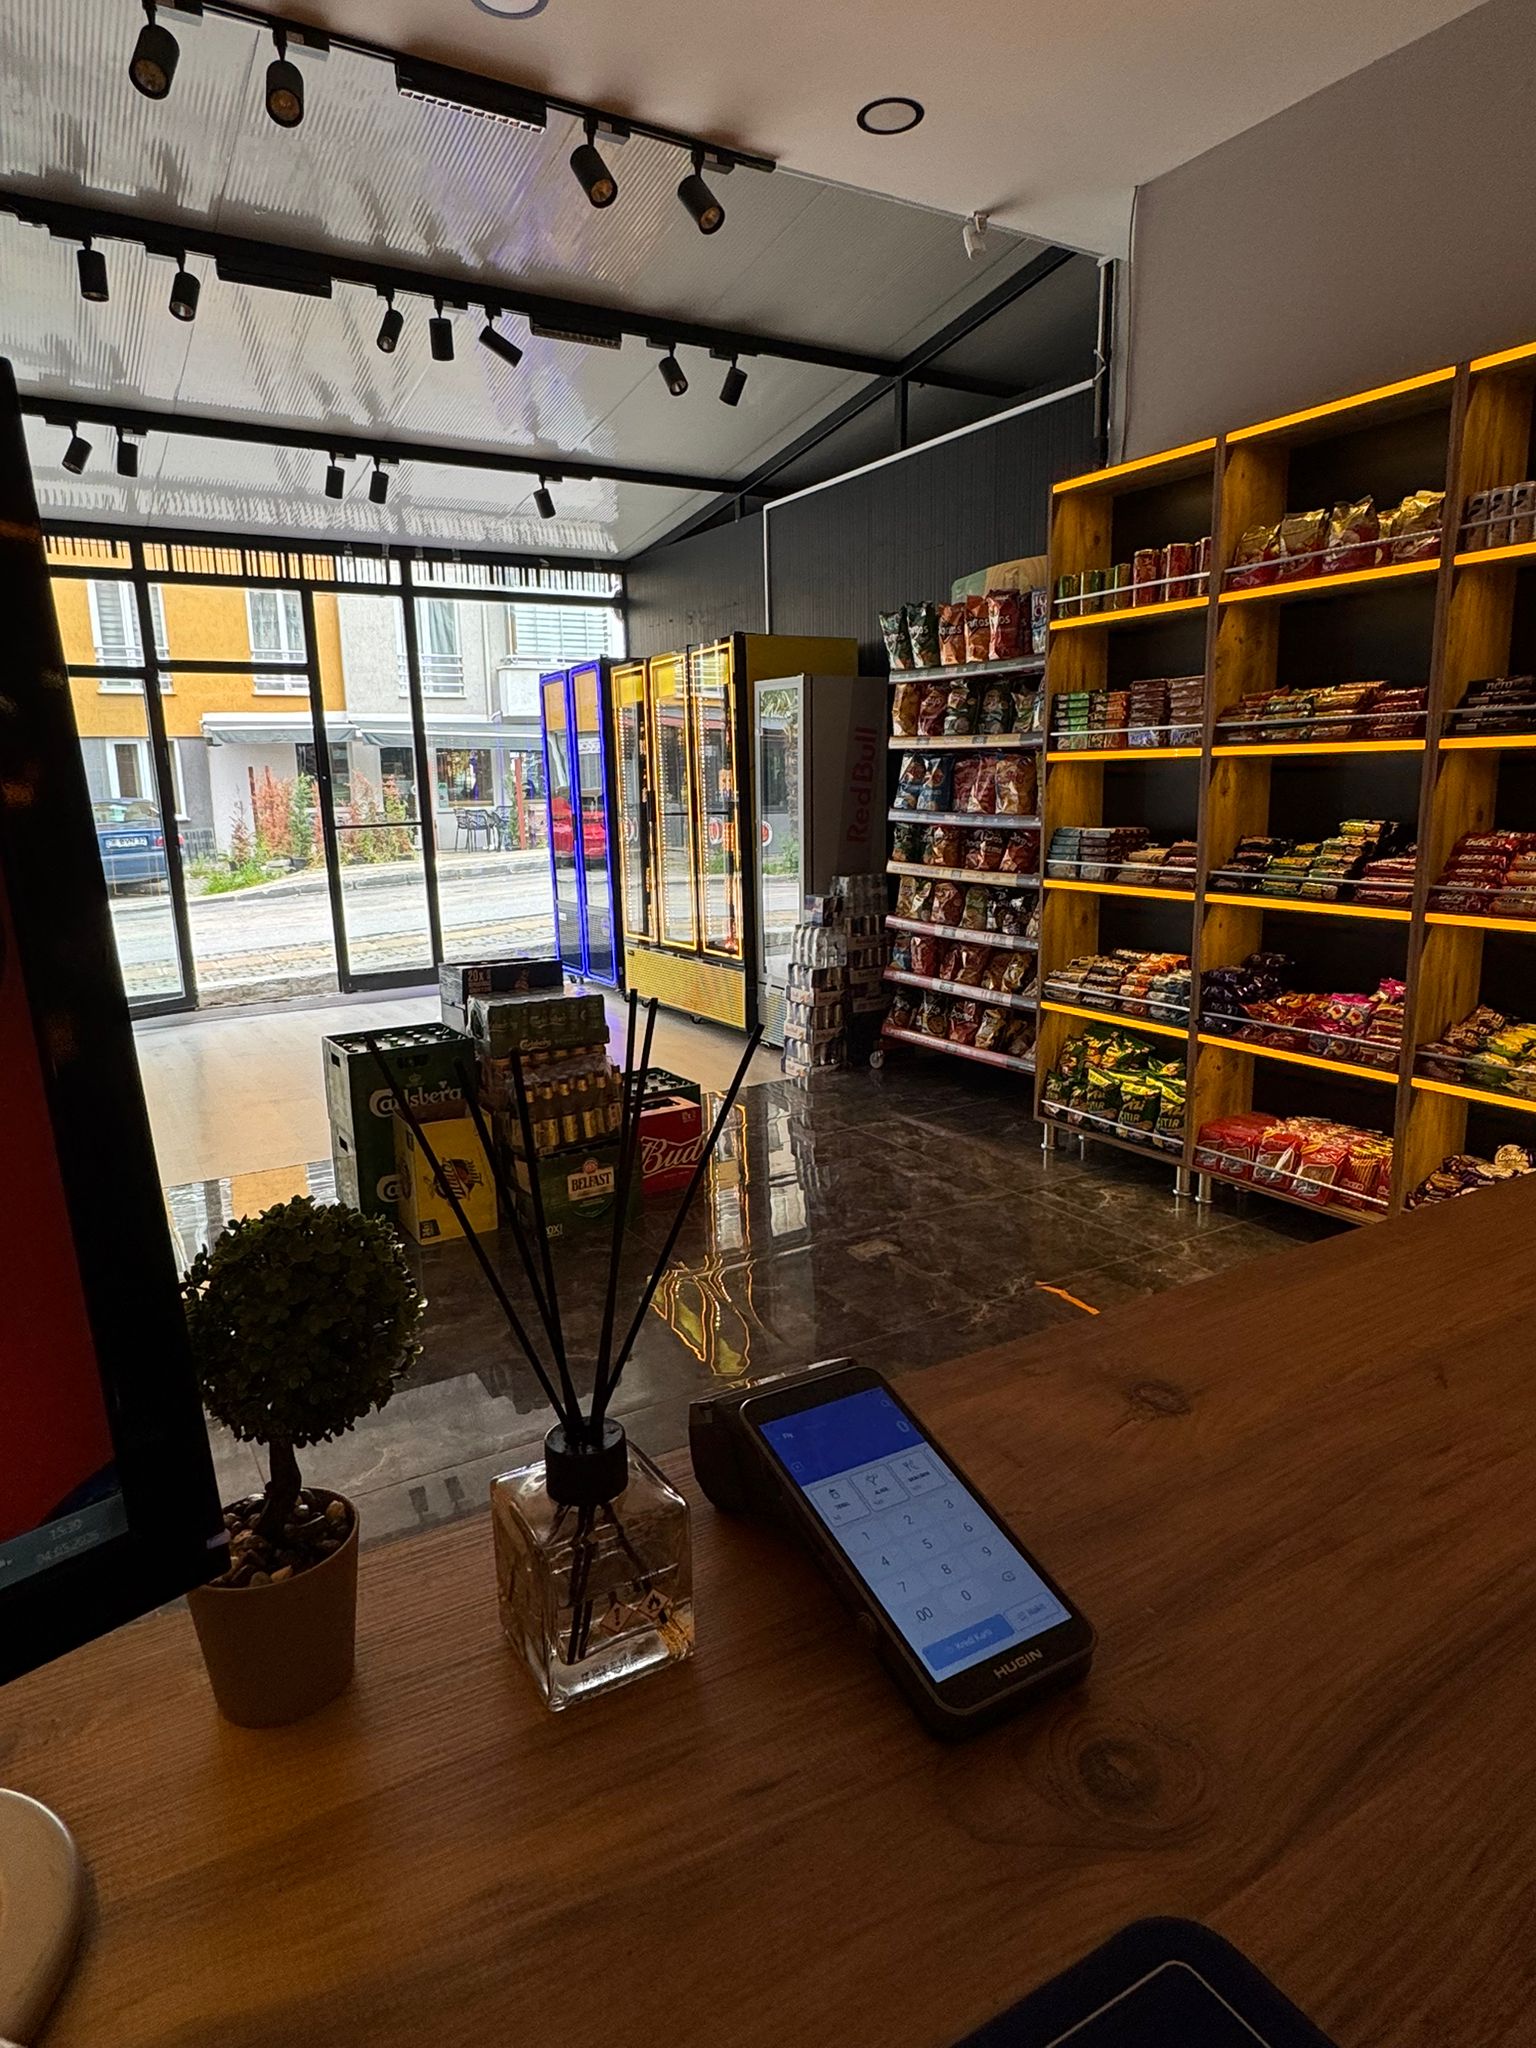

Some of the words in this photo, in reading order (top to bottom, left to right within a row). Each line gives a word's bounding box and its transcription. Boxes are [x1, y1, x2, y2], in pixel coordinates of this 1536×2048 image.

[642, 1136, 704, 1174] Bud
[571, 1171, 612, 1192] BELFAST
[903, 1515, 913, 1525] 2
[943, 1499, 954, 1509] 3
[881, 1556, 890, 1566] 4
[922, 1538, 933, 1549] 5
[963, 1522, 973, 1532] 6
[897, 1581, 908, 1592] 7
[941, 1564, 952, 1575] 8
[982, 1546, 992, 1557] 9
[916, 1606, 933, 1622] 00
[960, 1590, 972, 1601] 0
[992, 1648, 1043, 1679] HUGIN
